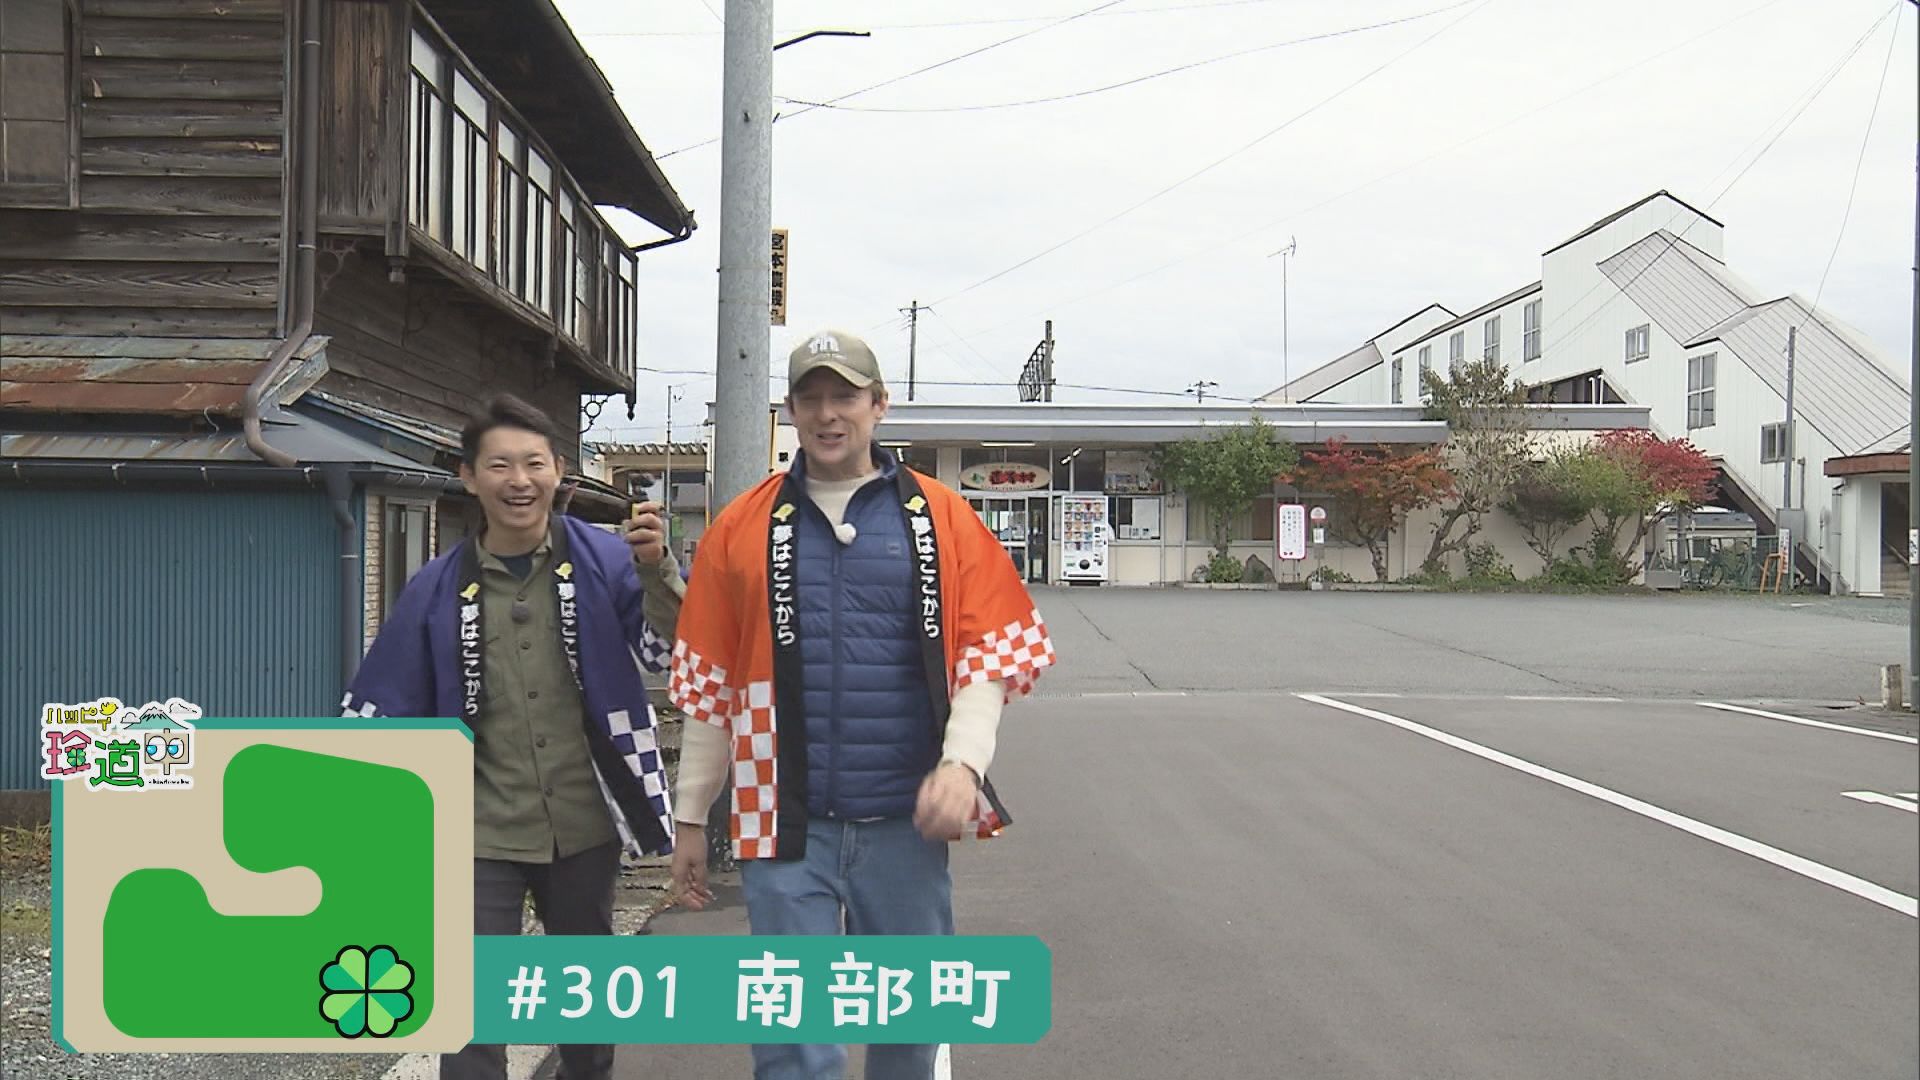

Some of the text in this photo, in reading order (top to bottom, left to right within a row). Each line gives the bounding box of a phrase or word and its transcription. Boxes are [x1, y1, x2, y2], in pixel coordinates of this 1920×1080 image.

[772, 525, 796, 646] 夢はここから
[910, 516, 939, 638] 夢はここから
[460, 604, 481, 715] 夢はここから
